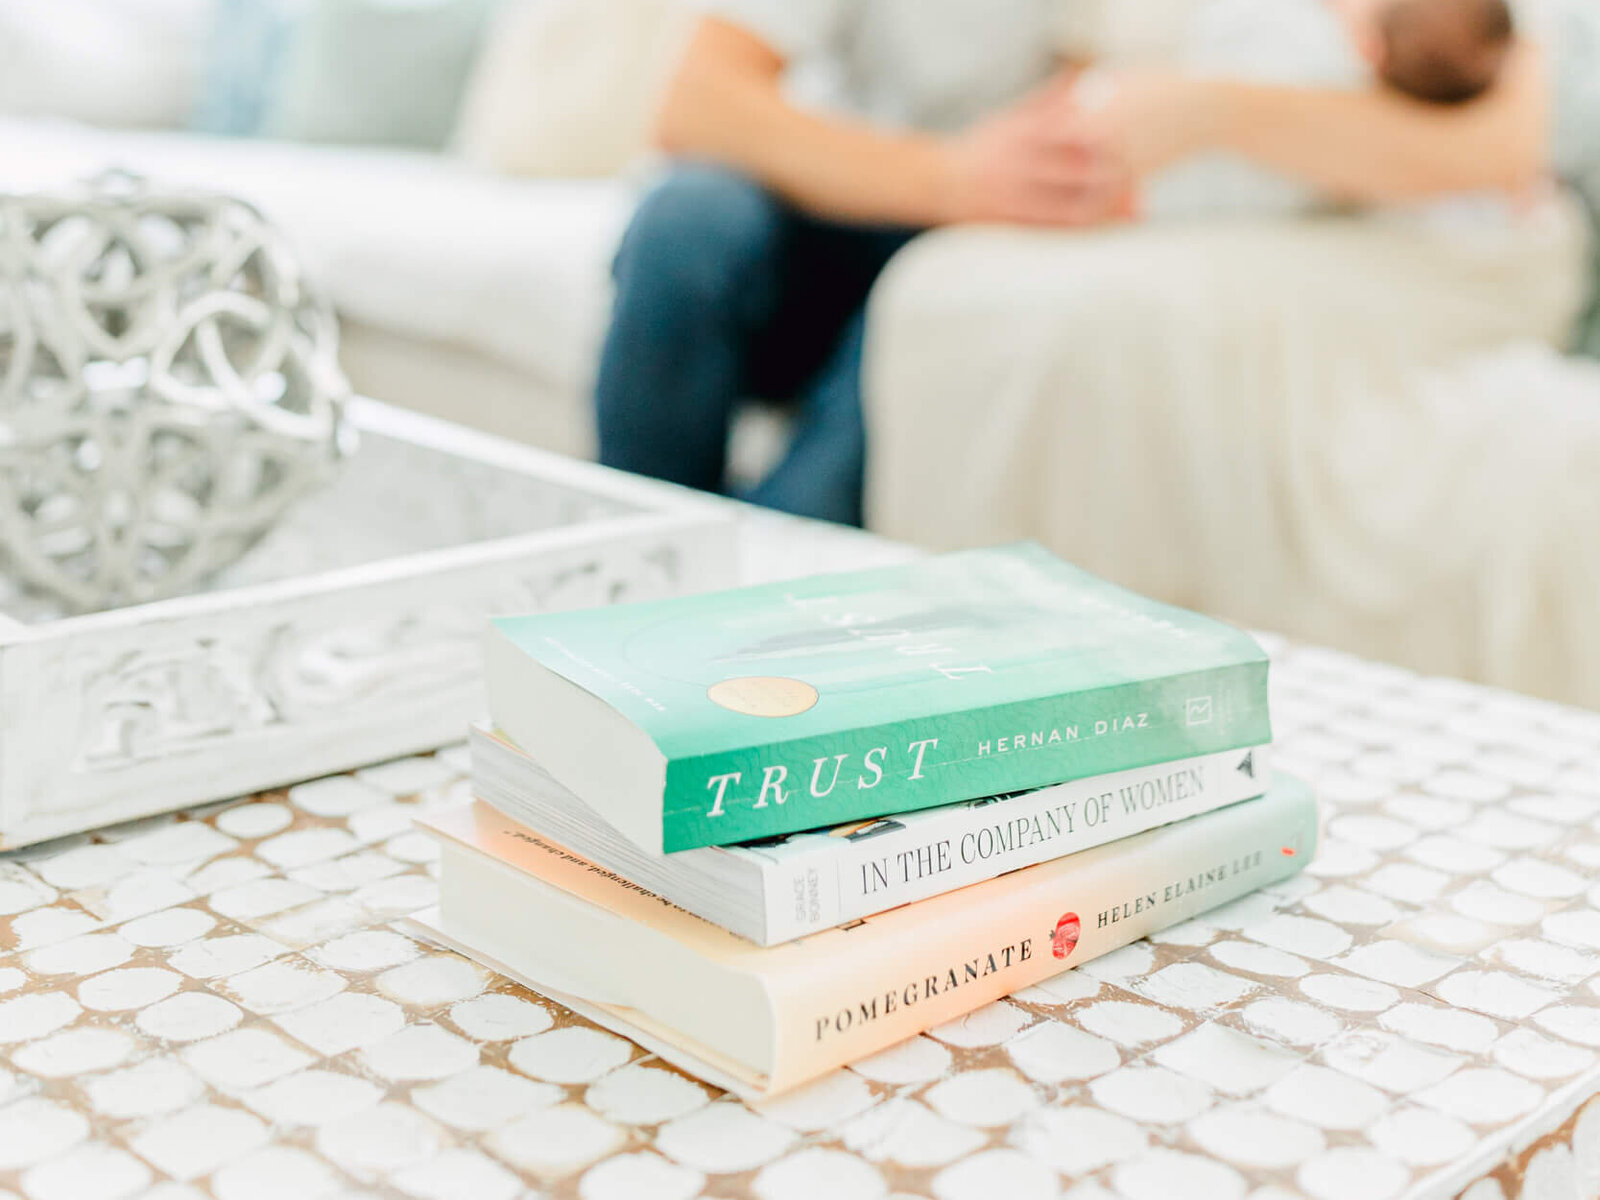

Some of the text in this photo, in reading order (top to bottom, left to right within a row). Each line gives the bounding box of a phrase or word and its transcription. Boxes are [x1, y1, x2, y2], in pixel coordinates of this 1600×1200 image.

[977, 713, 1149, 756] HERNAN DIAZ
[706, 738, 938, 817] TRUST
[860, 766, 1206, 895] IN THE COMPANY OF WOMEN
[1097, 850, 1263, 929] HELEN ELAINE LEE
[814, 938, 1033, 1041] POMEGRANATE
